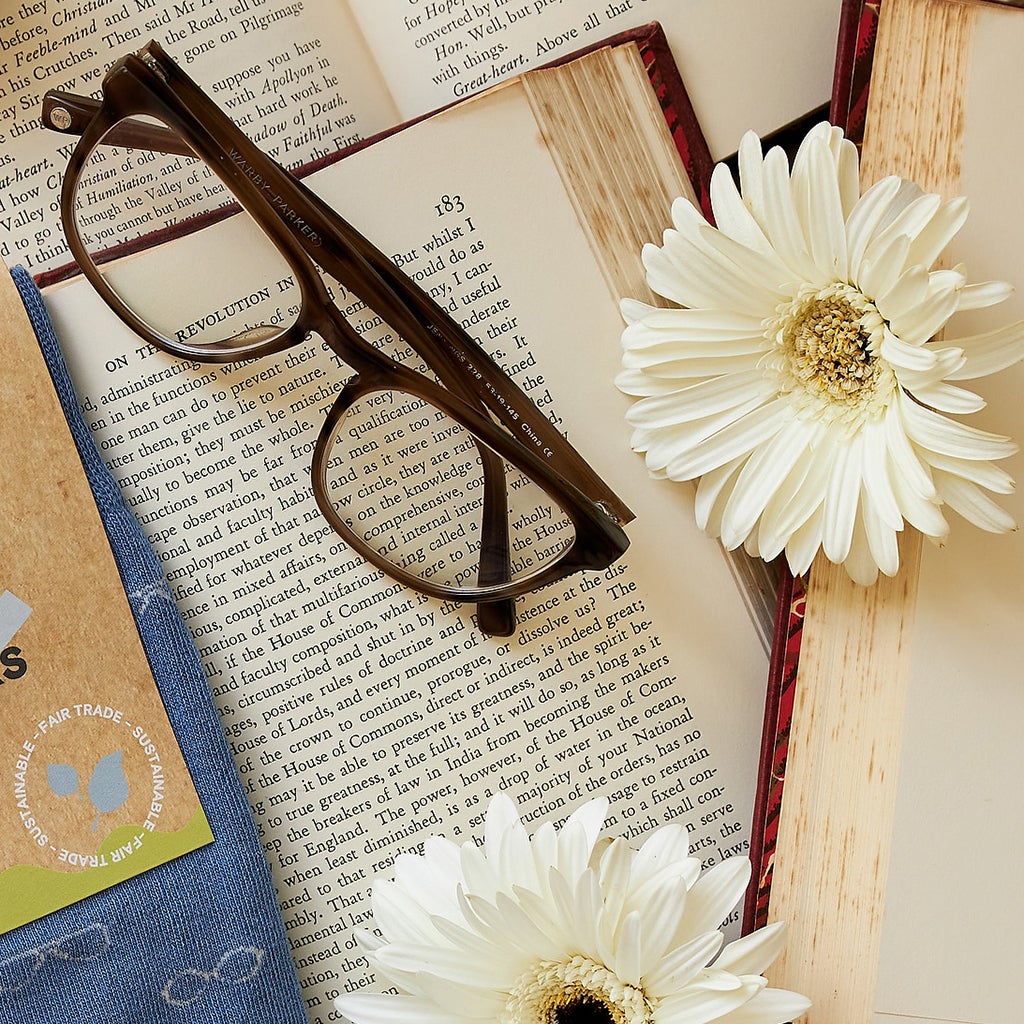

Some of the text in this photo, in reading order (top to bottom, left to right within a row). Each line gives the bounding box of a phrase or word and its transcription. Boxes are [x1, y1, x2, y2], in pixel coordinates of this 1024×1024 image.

[7, 75, 31, 93] his
[33, 47, 98, 80] Crutches.
[101, 27, 141, 49] Then
[211, 38, 321, 93] suppose you have
[224, 56, 330, 109] with Apollyon in
[432, 43, 508, 85] with things.
[453, 53, 529, 97] Great-heart.
[229, 148, 270, 190] WARBY
[434, 194, 464, 217] 183
[391, 216, 476, 268] But whilst I
[105, 275, 295, 372] ON TH REVOLUTION IN
[521, 422, 543, 447] China
[15, 704, 164, 867] FAIR TRADE SUSTAINABLE FAIR TRADE SUSTAINABLE
